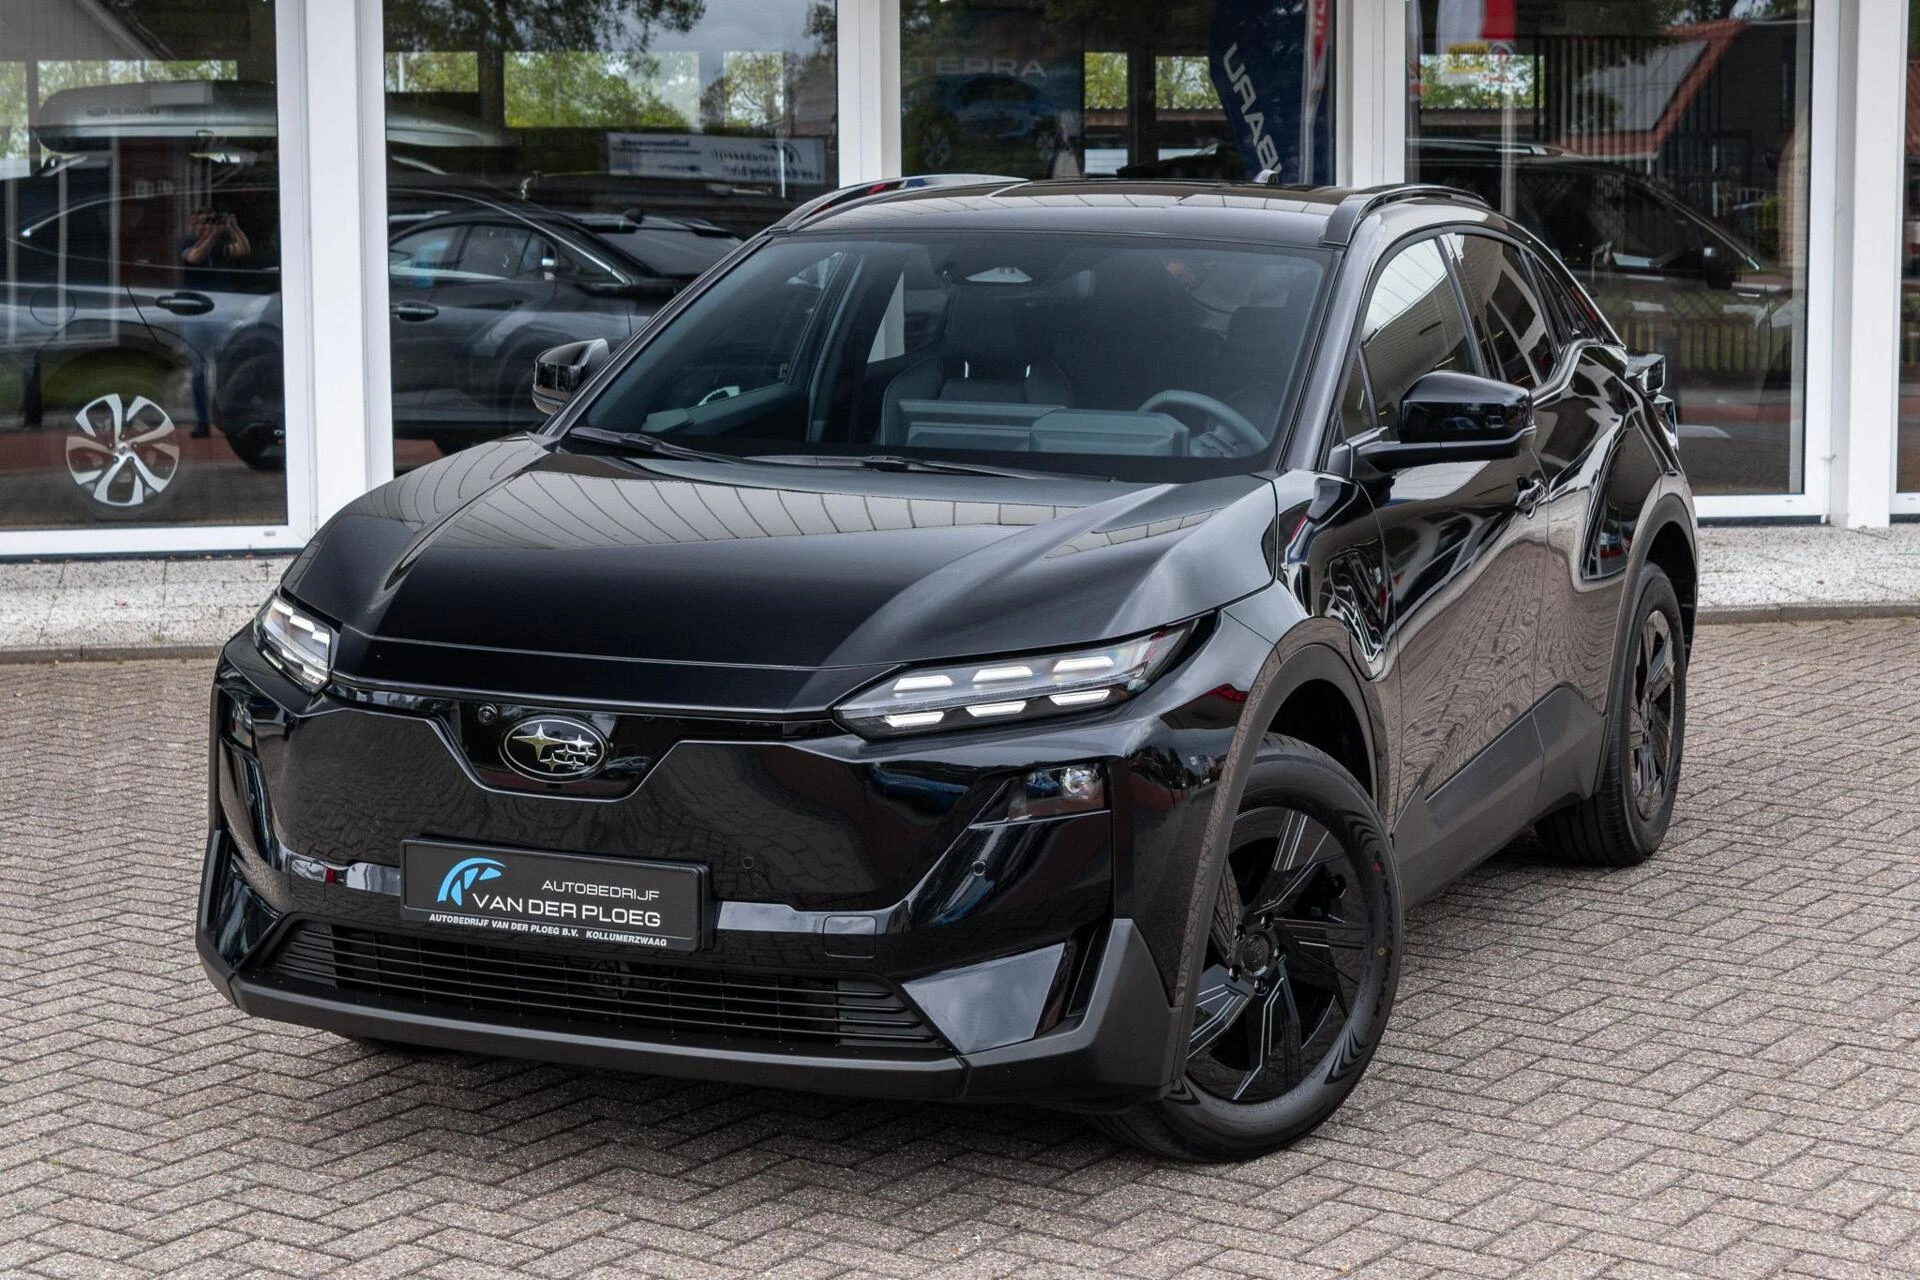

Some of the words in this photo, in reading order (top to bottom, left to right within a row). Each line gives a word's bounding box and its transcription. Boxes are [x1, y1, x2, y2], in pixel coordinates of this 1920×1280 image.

[541, 879, 660, 901] AUTOBEDRIJF
[472, 892, 523, 913] VAN
[527, 899, 577, 919] DER
[581, 905, 661, 927] PLOEG
[429, 913, 489, 927] AUTOBEDRIJF
[491, 920, 509, 929] VAN
[510, 922, 529, 932] DER
[530, 924, 560, 935] PLOEG
[562, 928, 579, 937] B.V.
[586, 930, 667, 947] KOLLUMERZWAAG
